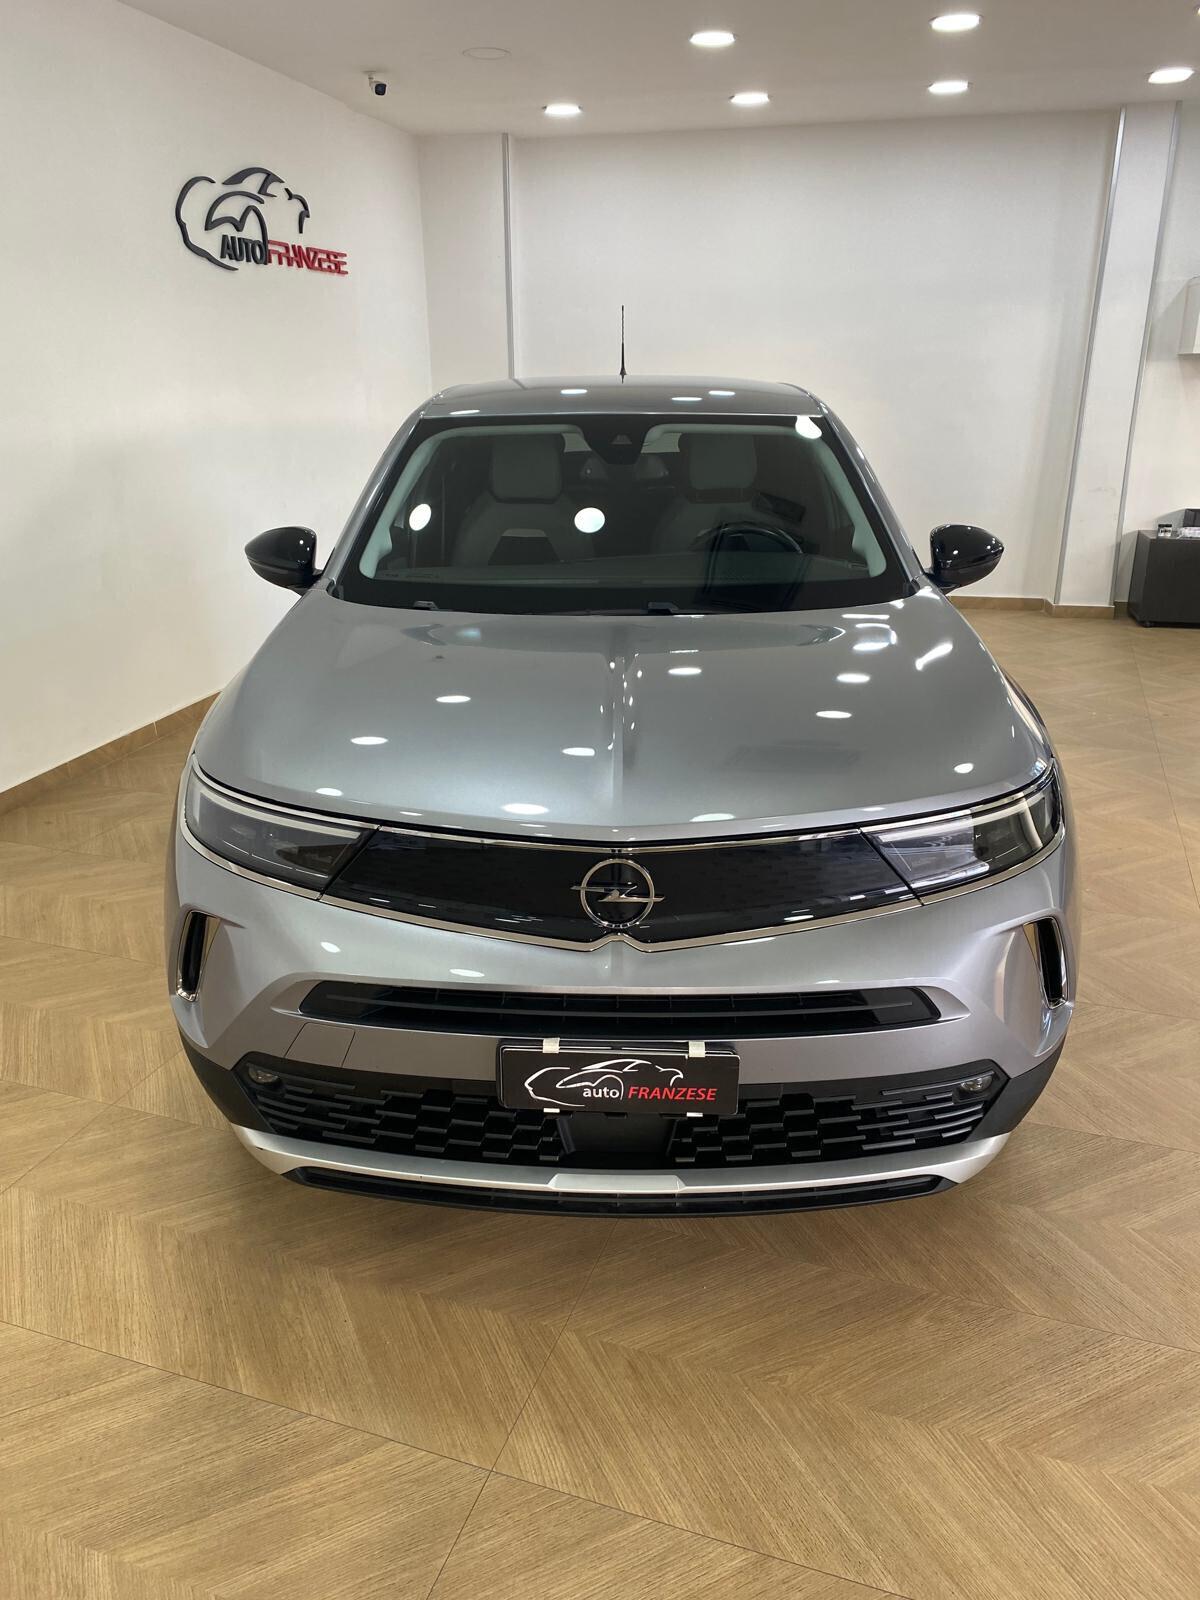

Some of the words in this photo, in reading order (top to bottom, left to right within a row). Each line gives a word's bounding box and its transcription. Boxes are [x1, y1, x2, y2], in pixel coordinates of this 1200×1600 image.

[220, 234, 265, 265] AUTO
[267, 239, 348, 274] FRANZESE
[583, 1086, 619, 1098] auto
[628, 1086, 717, 1101] FRANZESE
